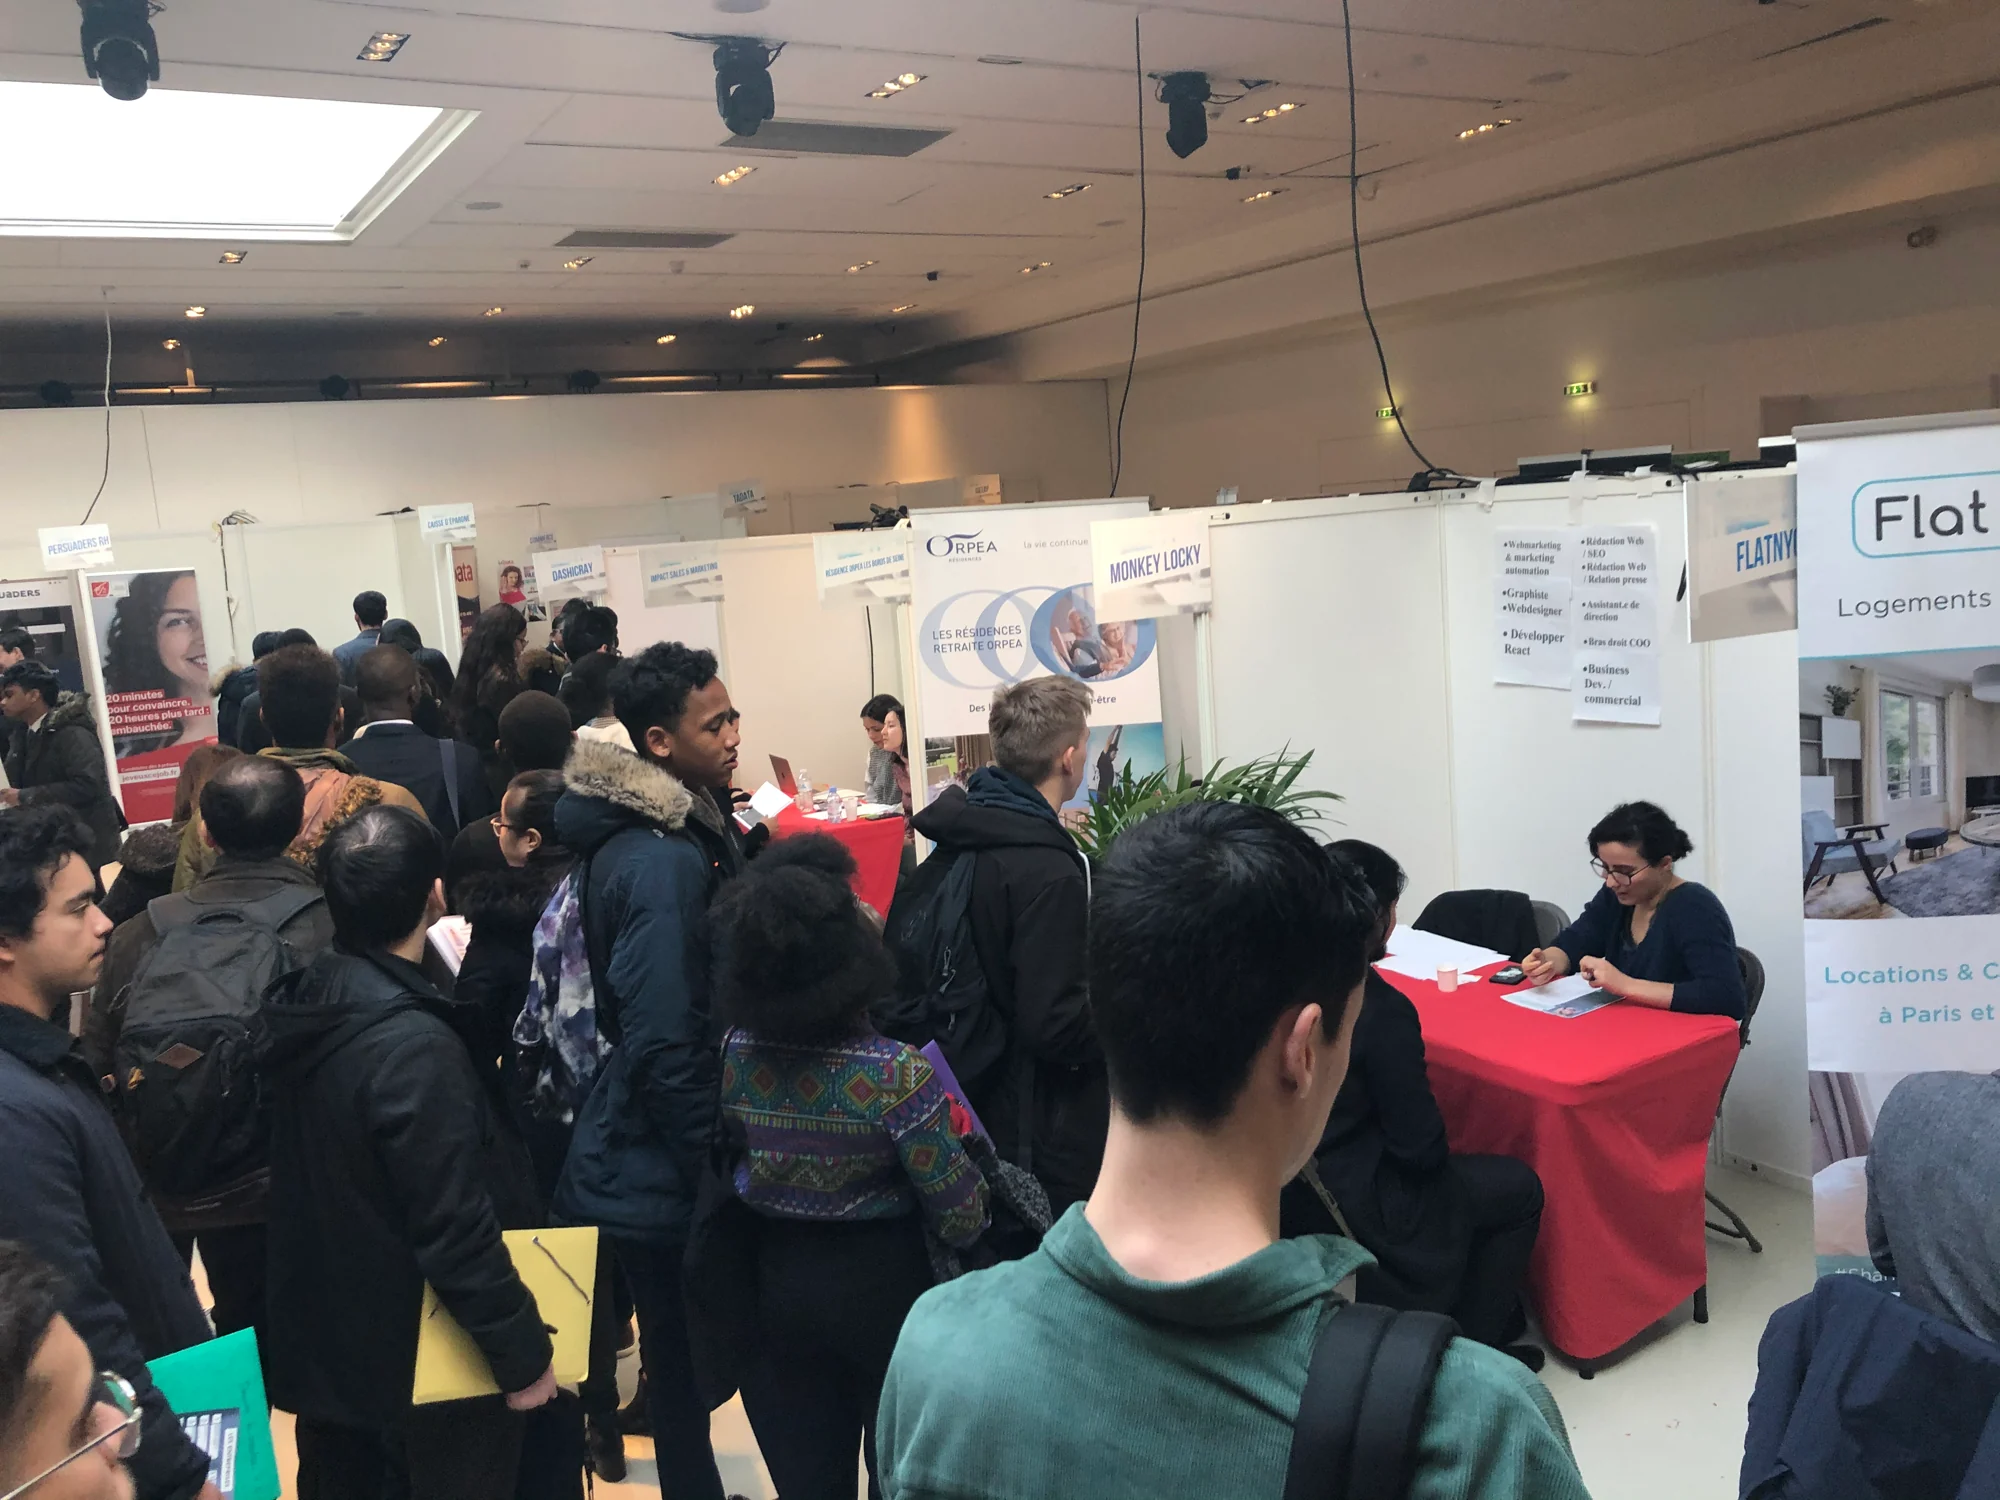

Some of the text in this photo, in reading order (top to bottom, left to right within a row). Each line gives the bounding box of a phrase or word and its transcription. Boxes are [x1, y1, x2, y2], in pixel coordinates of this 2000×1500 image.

[1875, 489, 1989, 542] Flat
[427, 518, 444, 529] CAISSE
[48, 536, 110, 555] PERSUADERS RH
[926, 532, 998, 558] ORPEA
[1023, 538, 1089, 549] la vie continue
[1508, 540, 1561, 551] Webmarketing
[1586, 536, 1644, 546] Rédaction Web
[1110, 543, 1201, 584] MONKEY LOCKY
[1505, 553, 1555, 564] & marketing
[454, 562, 473, 582] ata
[552, 562, 593, 582] DASHICRAY
[670, 568, 686, 579] SALES
[690, 562, 718, 574] MARKETING
[1506, 566, 1550, 576] automation
[1587, 562, 1646, 571] Rédaction Web
[1588, 575, 1620, 584] Relation
[1622, 577, 1648, 586] presse
[1507, 588, 1548, 600] Graphiste
[1630, 600, 1640, 609] de
[1838, 588, 1992, 618] Logements
[1508, 603, 1563, 617] Webdesigner
[1584, 612, 1618, 621] direction
[932, 625, 1022, 640] LES RÉSIDENCES
[1510, 628, 1564, 644] Développer
[934, 639, 1023, 653] RETRAITE ORPEA
[1588, 637, 1651, 648] Bras droit COO
[1504, 644, 1530, 656] React
[1588, 664, 1630, 675] Business
[1584, 678, 1606, 689] Dev.
[122, 690, 164, 702] minutes
[1584, 695, 1642, 706] commercial
[108, 699, 191, 714] pour convaincre.
[969, 704, 986, 712] Des
[109, 716, 122, 724] 20
[124, 713, 160, 724] heures
[162, 710, 182, 720] plus
[184, 707, 204, 716] tard
[112, 721, 172, 736] embauchée.
[1824, 966, 1948, 984] Locations
[1957, 964, 1973, 980] &
[1879, 1004, 1995, 1024] à Paris et
